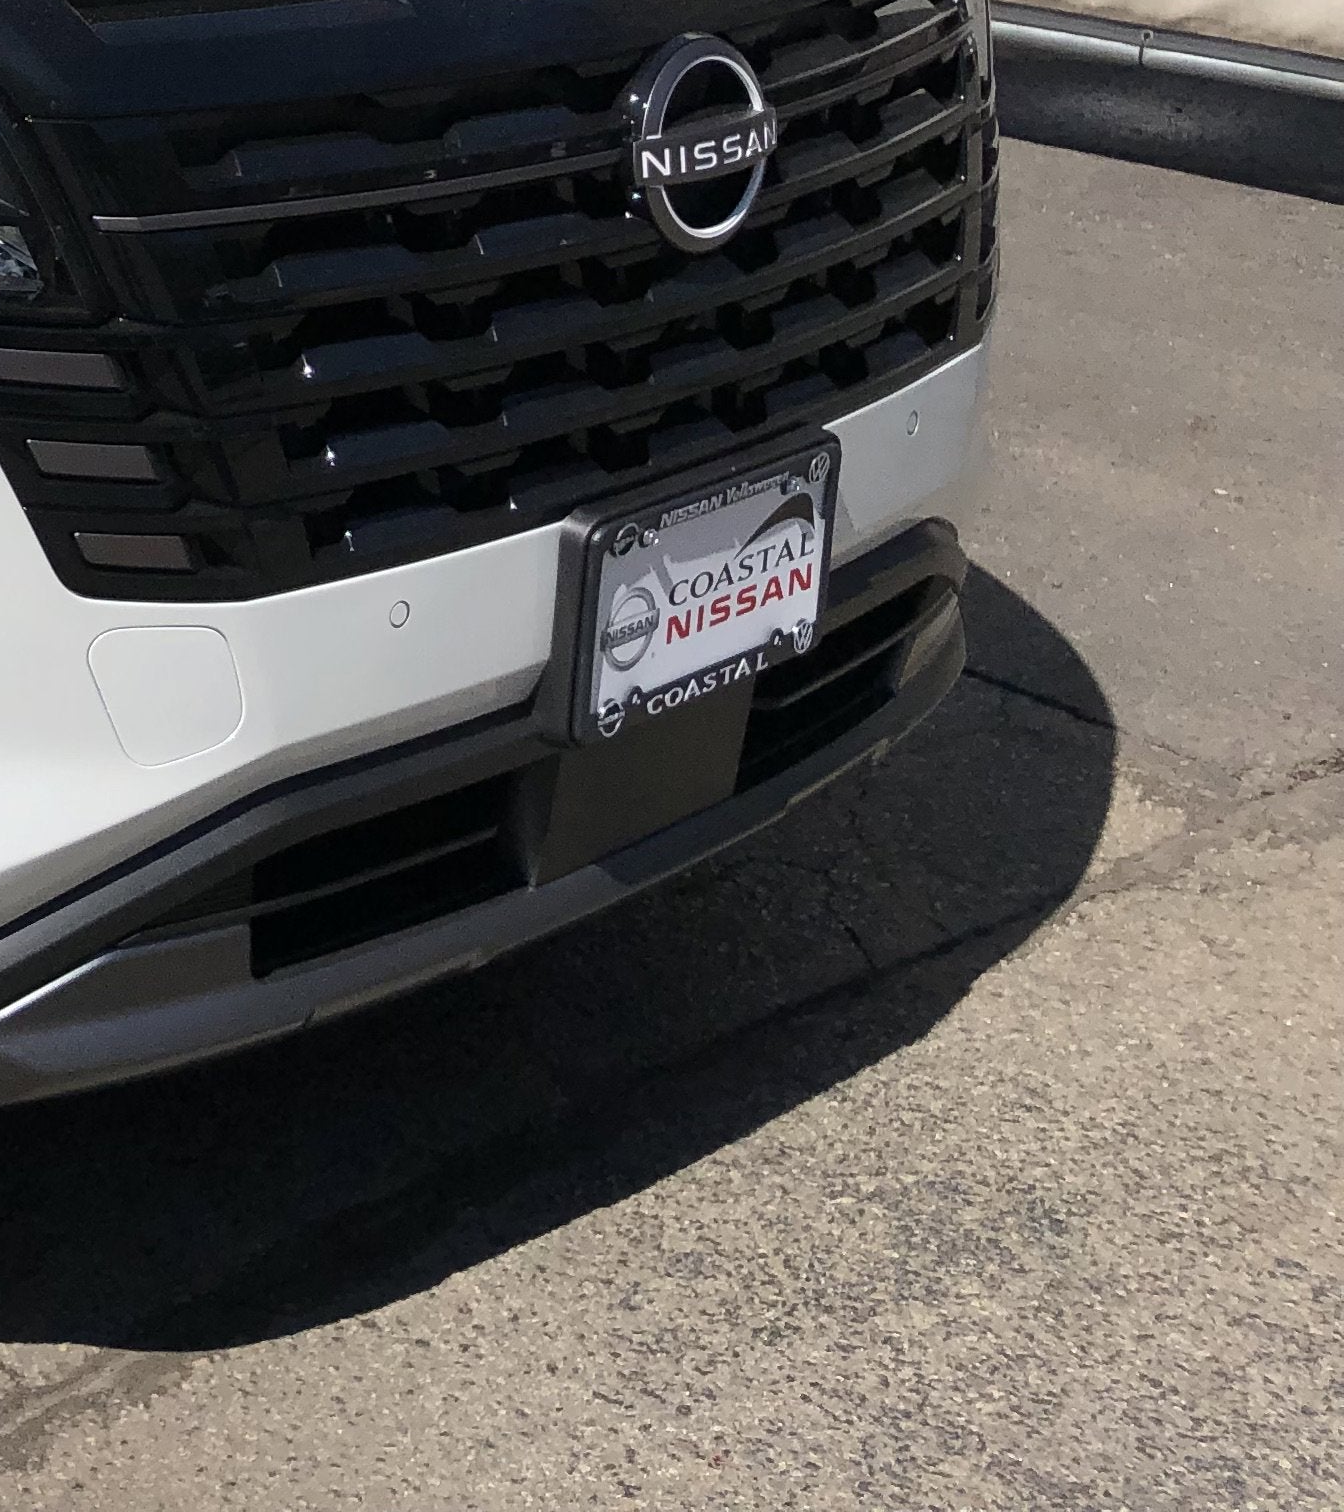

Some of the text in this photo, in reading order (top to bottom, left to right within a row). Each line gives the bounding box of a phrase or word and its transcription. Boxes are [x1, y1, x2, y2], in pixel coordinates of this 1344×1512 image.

[641, 120, 777, 178] NISSAN
[660, 493, 724, 529] NISSAN
[668, 532, 815, 606] COASTAL
[606, 615, 655, 643] NISSAN
[665, 563, 813, 645] NISSAN
[646, 652, 769, 715] COASTAL
